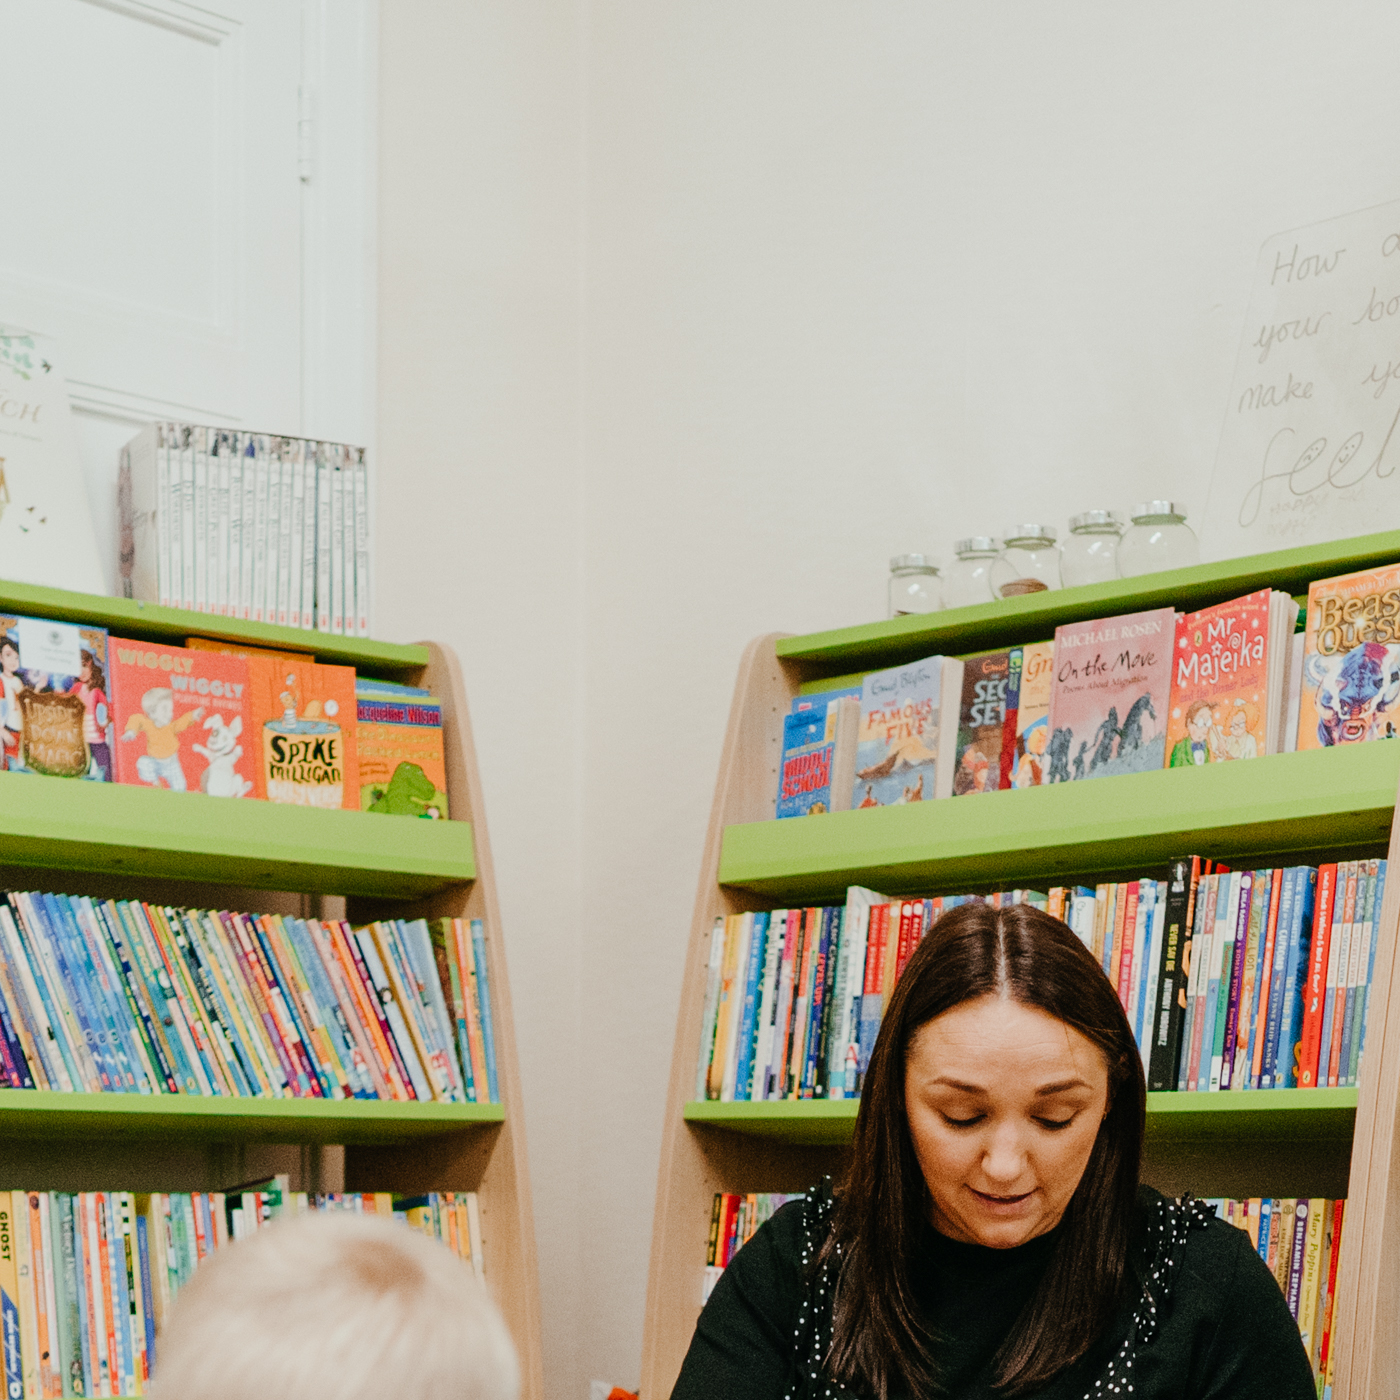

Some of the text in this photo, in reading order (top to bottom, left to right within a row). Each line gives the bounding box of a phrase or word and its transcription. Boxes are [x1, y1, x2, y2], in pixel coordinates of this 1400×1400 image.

[1271, 244, 1347, 286] How
[1253, 311, 1332, 365] your
[1238, 372, 1314, 413] make
[1060, 621, 1163, 650] MICHAEL ROSEN
[1207, 617, 1236, 642] Mr
[116, 648, 194, 675] WIGGLY
[1058, 650, 1159, 683] On the Move
[1177, 630, 1265, 686] Majeika
[169, 674, 244, 699] WIGGLY
[1112, 675, 1148, 688] Migration
[867, 698, 933, 730] FAMOUS
[885, 716, 927, 746] FIVE
[270, 734, 338, 764] SPIKE
[784, 747, 833, 774] MIDDLE
[782, 770, 830, 800] SCHOOL
